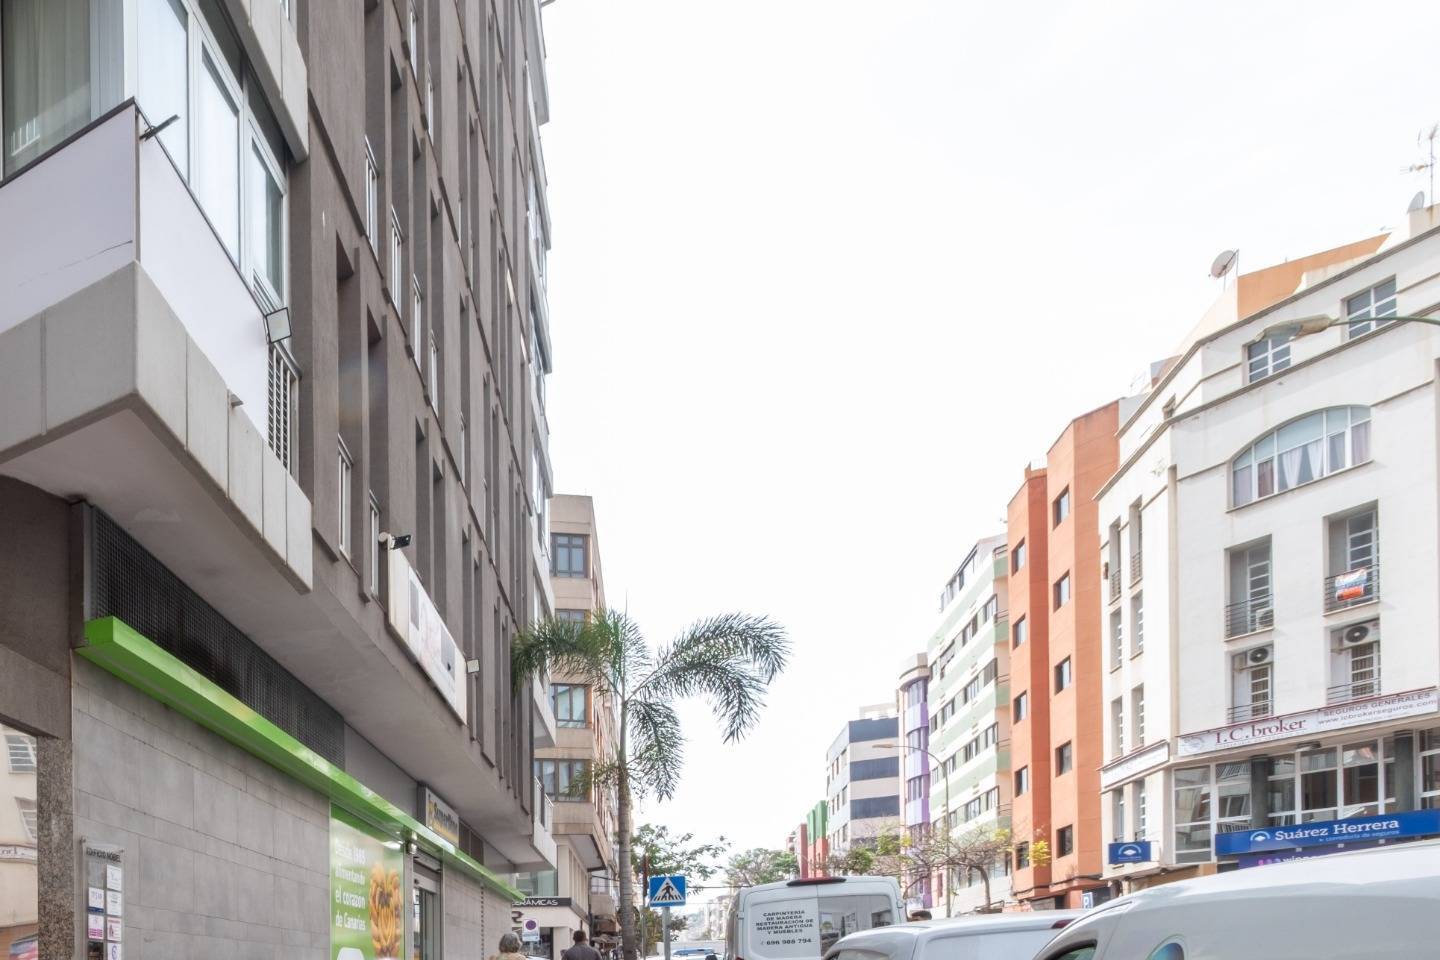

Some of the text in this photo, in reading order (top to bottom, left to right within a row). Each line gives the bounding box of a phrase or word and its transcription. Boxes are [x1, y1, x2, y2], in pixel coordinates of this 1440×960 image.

[1371, 692, 1431, 708] GENERALES
[1274, 819, 1400, 841] Suárez Herrera
